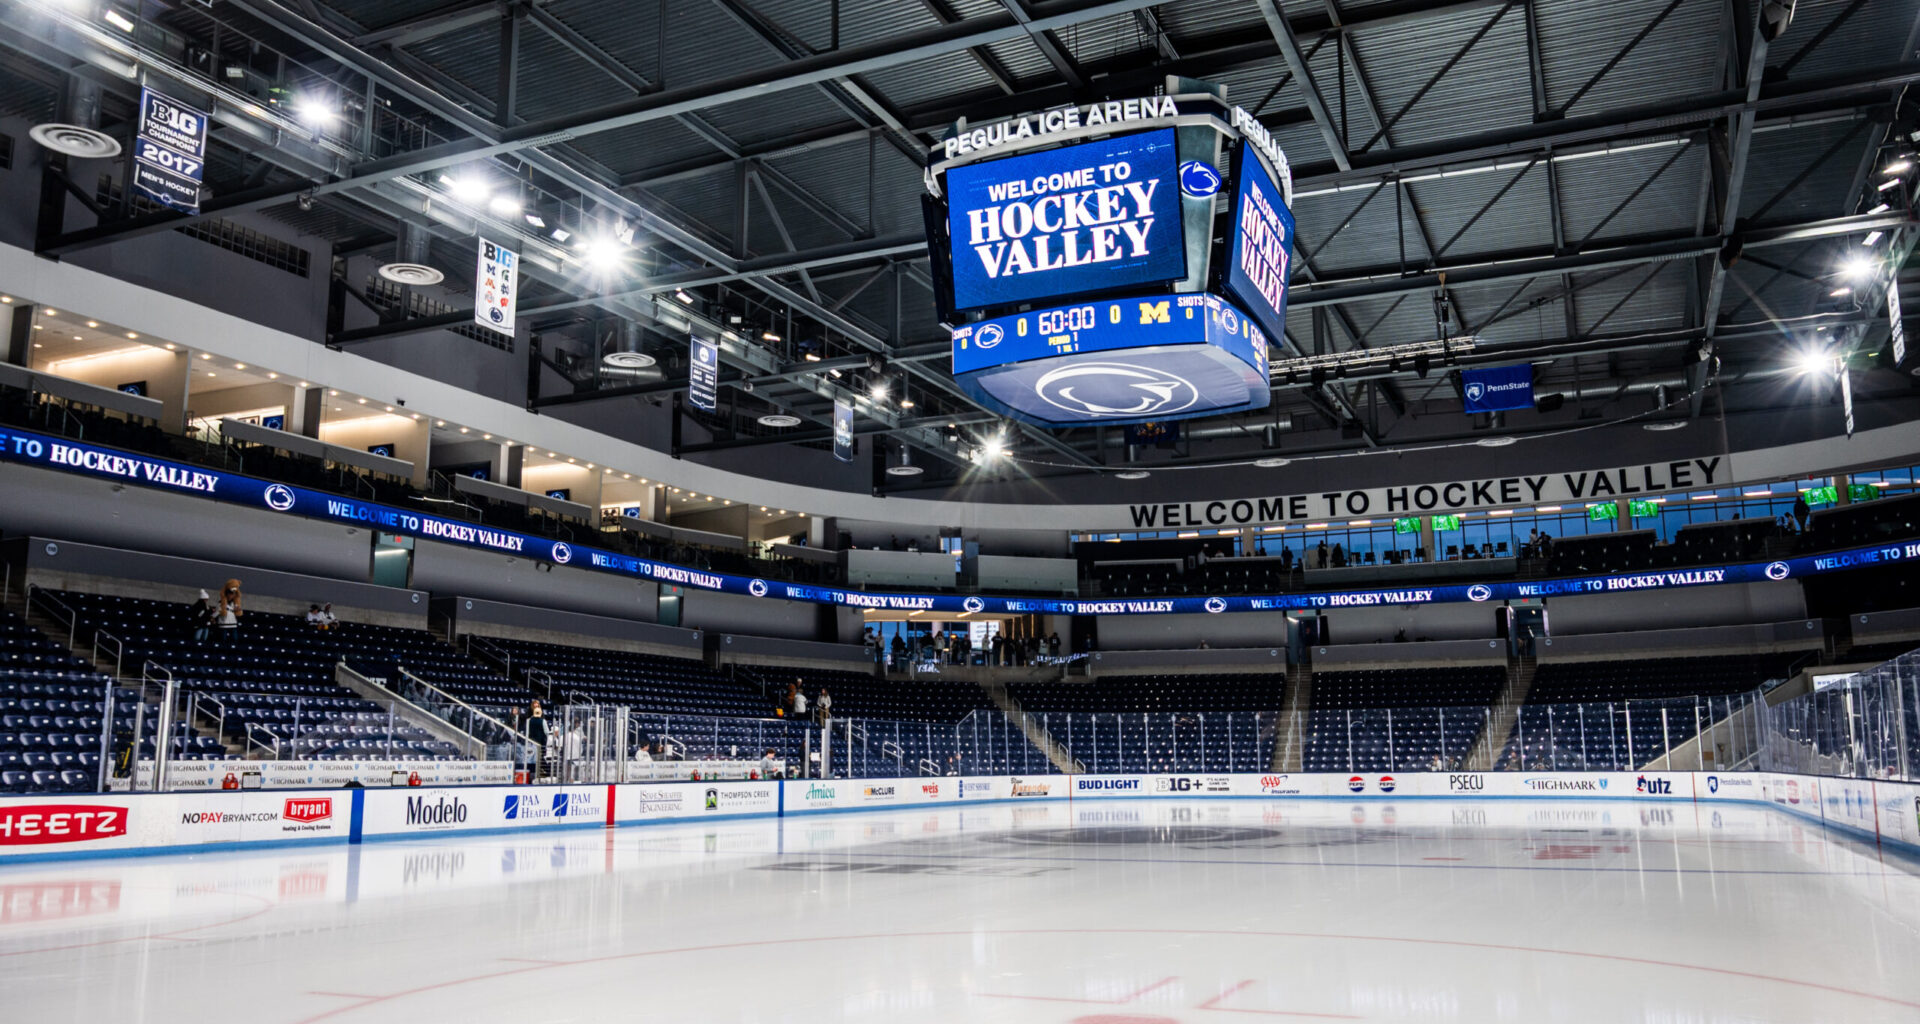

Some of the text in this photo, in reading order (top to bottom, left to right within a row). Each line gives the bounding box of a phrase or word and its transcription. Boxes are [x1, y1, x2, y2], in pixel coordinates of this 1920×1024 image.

[146, 119, 201, 147] TOURNAMENT
[945, 94, 1179, 159] PEGULA ICE ARENA
[1231, 105, 1279, 162] PEGULA
[148, 130, 196, 154] CHAMPIONS
[142, 143, 199, 176] 2017
[141, 170, 196, 197] MEN'S HOCKEY
[988, 167, 1096, 203] WELCOME
[1099, 161, 1132, 183] TO
[967, 178, 1160, 246] HOCKEY
[1251, 179, 1286, 242] WELCOME TO
[974, 216, 1155, 279] VALLEY
[1242, 192, 1289, 283] HOCKEY
[1241, 230, 1284, 315] VALLEY
[1177, 296, 1204, 308] SHOTS
[1185, 307, 1193, 320] 0
[1017, 300, 1171, 337] 0 60:00 0 M
[953, 326, 973, 341] SHOTS
[961, 338, 968, 350] 0
[1048, 331, 1079, 346] PERIOD 1
[11, 435, 43, 458] TO
[50, 443, 142, 477] HOCKEY
[144, 459, 220, 493] VALLEY
[1130, 457, 1722, 528] WELCOME TO HOCKEY VALLEY
[327, 499, 525, 552] WELCOME TO HOCKEY VALLEY
[1814, 551, 1880, 571] WELCOME
[1881, 548, 1901, 561] TO
[591, 553, 723, 590] WELCOME TO HOCKEY VALLEY
[1518, 569, 1725, 596] WELCOME TO HOCKEY VALLEY
[786, 586, 935, 609] WELCOME TO HOCKEY VALLEY
[1006, 600, 1174, 614] WELCOME TO HOCKEY VALLEY
[1250, 590, 1433, 609] WELCOME TO HOCKEY VALLEY
[273, 764, 308, 773] HIGHMARK
[805, 782, 836, 801] Amica
[872, 786, 895, 797] McCLURE
[922, 782, 939, 793] weis
[1078, 779, 1140, 790] BUD LIGHT
[1261, 776, 1281, 788] AAA
[1450, 774, 1484, 791] PSECU
[1532, 779, 1597, 791] HIGHMARK
[572, 793, 591, 805] PAM
[720, 790, 770, 800] THOMPSON CREEK
[182, 811, 278, 825] NOPAYBRYANT.COM
[290, 801, 327, 818] bryant
[406, 795, 468, 825] Modelo
